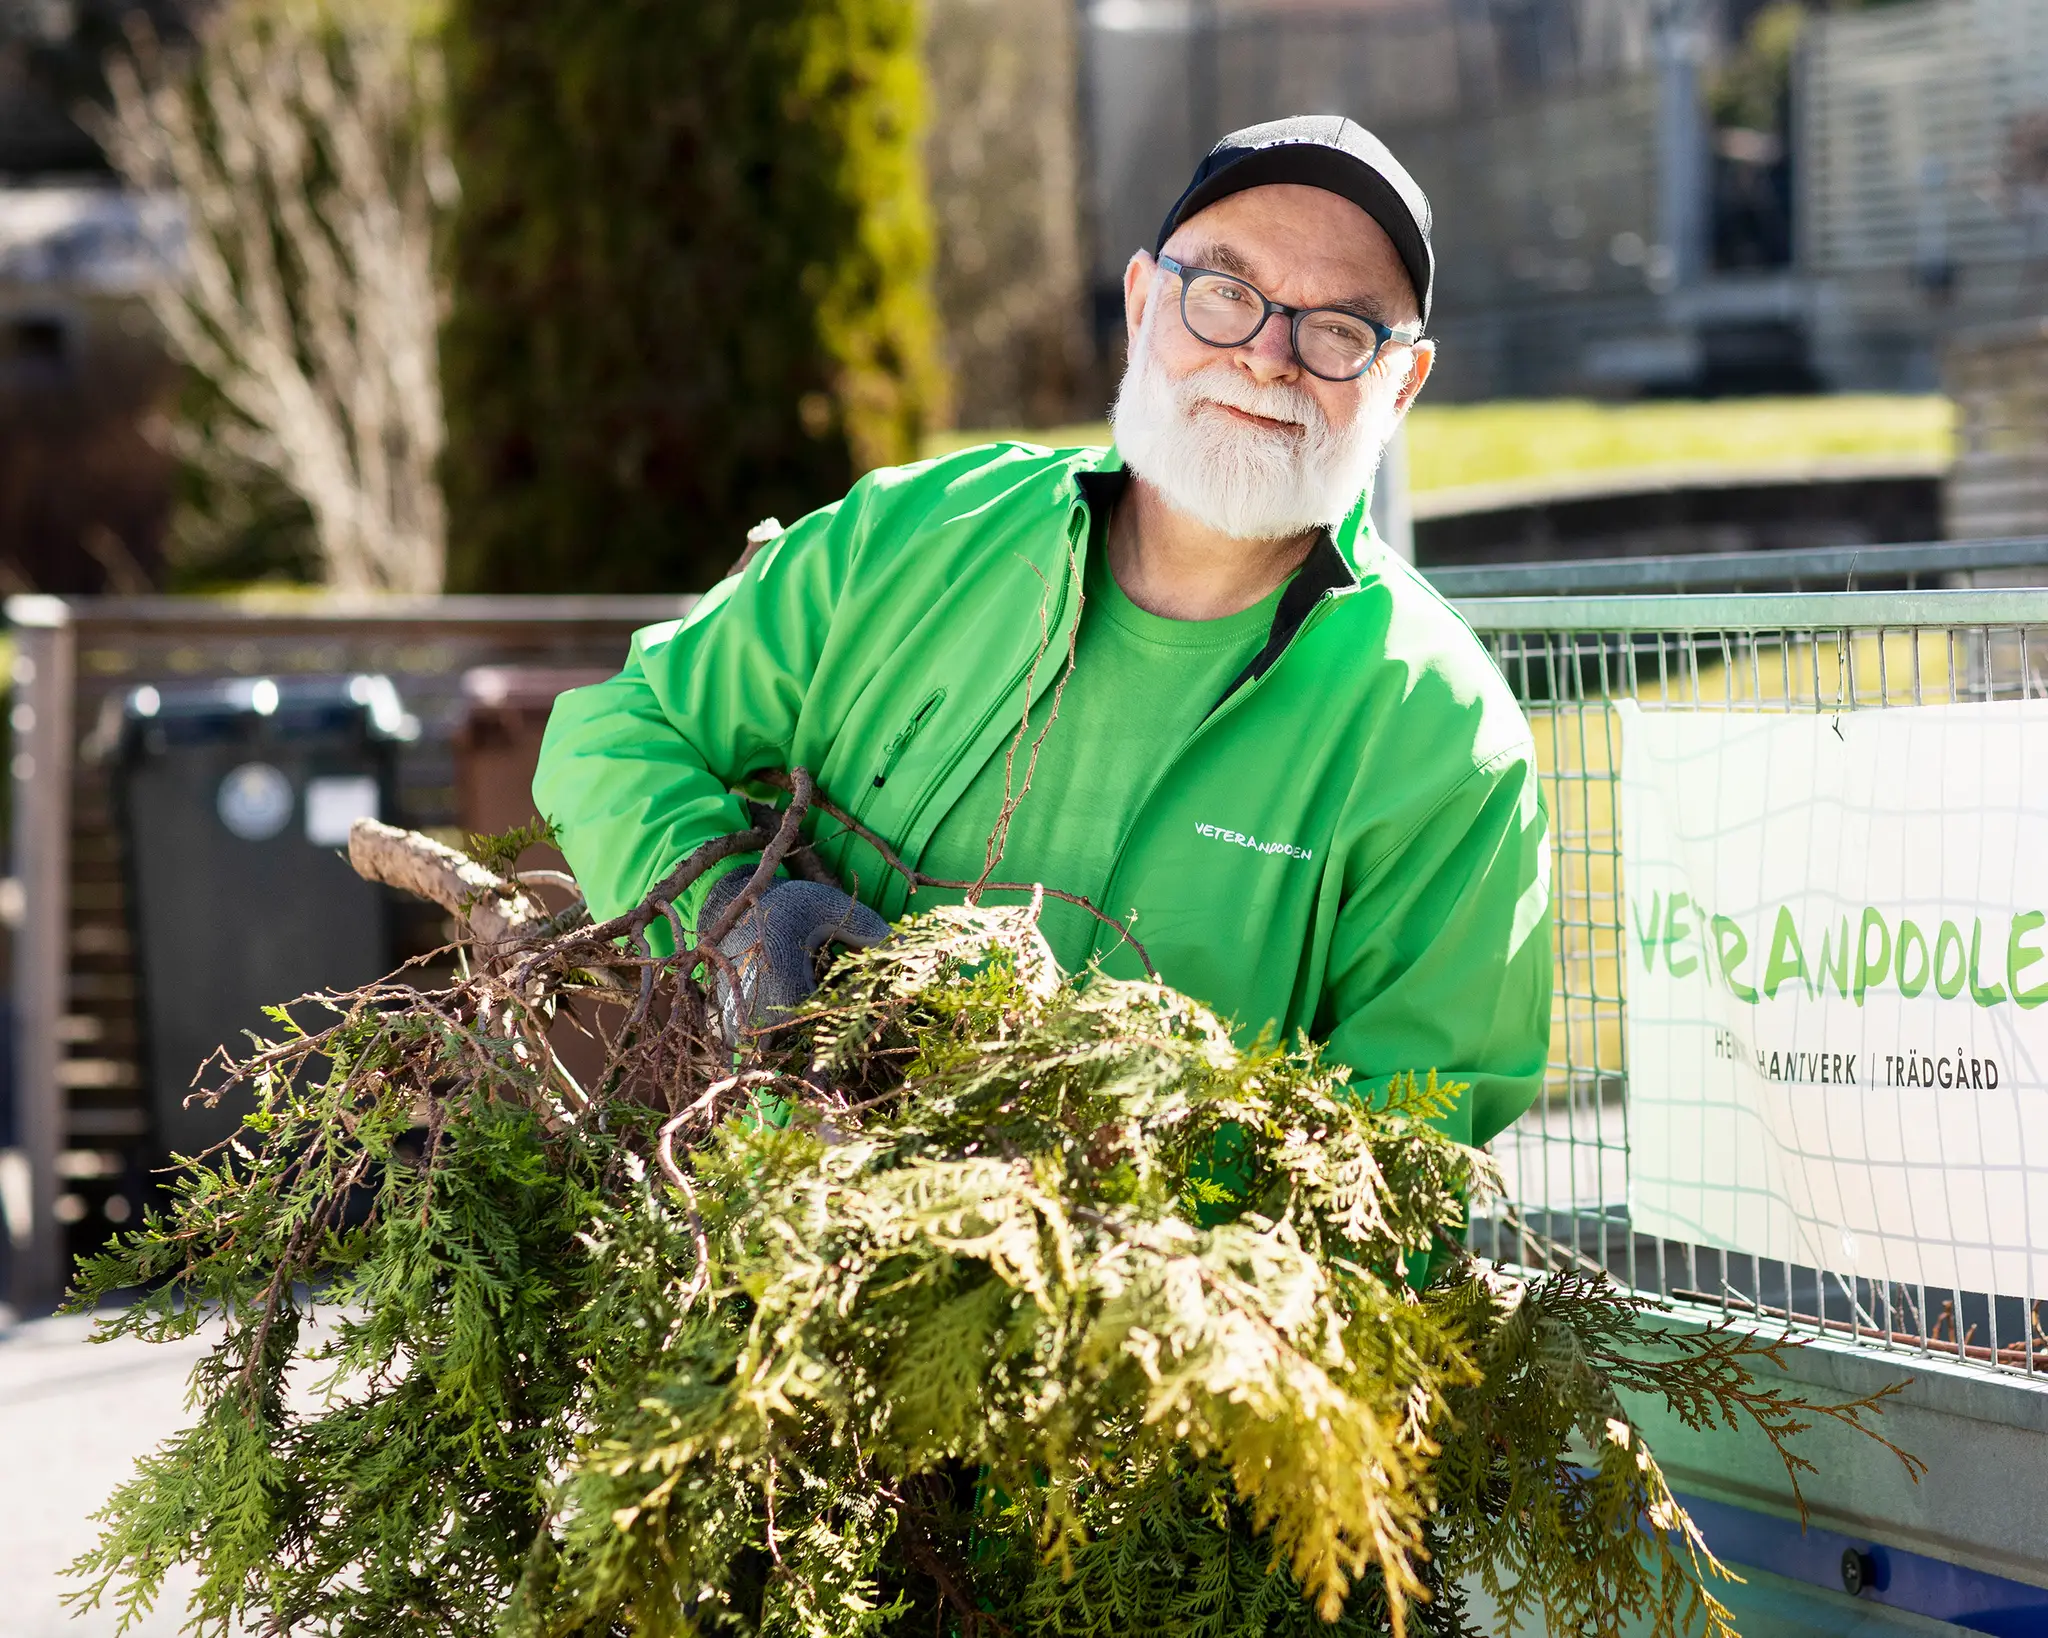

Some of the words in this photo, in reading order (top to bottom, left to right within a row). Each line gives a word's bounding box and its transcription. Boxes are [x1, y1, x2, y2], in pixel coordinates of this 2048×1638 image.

[1195, 822, 1312, 860] VETERANPOOEN
[1756, 1050, 1857, 1085] HANTVERK
[1885, 1047, 1999, 1090] TRÄDGÅRD
